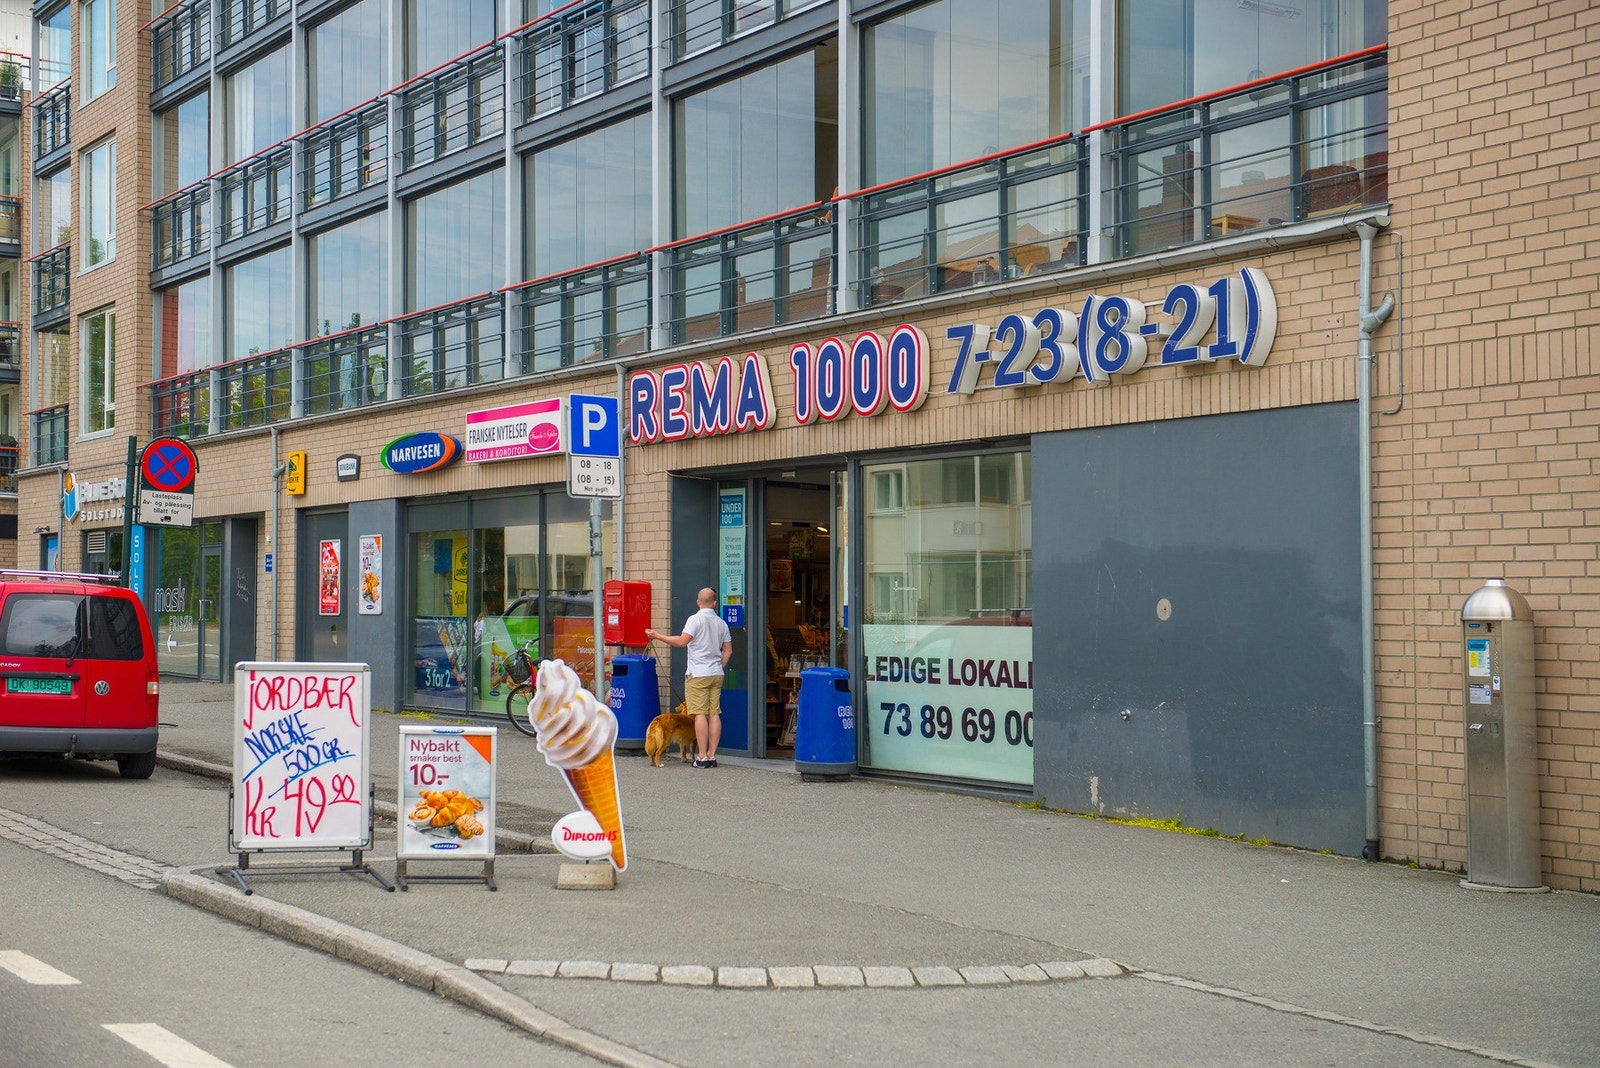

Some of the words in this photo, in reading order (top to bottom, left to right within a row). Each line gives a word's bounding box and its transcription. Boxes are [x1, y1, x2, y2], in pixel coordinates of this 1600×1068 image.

[946, 308, 1066, 394] 7-23
[1078, 266, 1264, 385] (8-21)
[629, 352, 772, 445] REMA
[790, 323, 926, 425] 1000
[468, 426, 496, 445] FRANSKE
[496, 422, 528, 442] NYTELSER
[582, 404, 608, 448] P
[391, 443, 441, 463] NARVESEN
[468, 451, 489, 461] BAKERI
[490, 450, 495, 458] &
[495, 446, 528, 459] KONDITORI
[580, 460, 592, 469] 08
[603, 461, 612, 470] 18
[577, 473, 592, 484] (08
[603, 475, 615, 486] 15)
[151, 492, 183, 501] Lasteplass
[153, 507, 168, 515] tillatt
[170, 508, 180, 516] for
[164, 500, 192, 510] pålessing
[721, 503, 742, 513] UNDER
[455, 568, 468, 576] DIRE
[425, 668, 431, 687] 3
[432, 669, 444, 687] for
[445, 670, 451, 687] 2
[864, 655, 941, 685] LEDIGE
[11, 679, 26, 689] DK
[32, 679, 69, 691] 90549
[880, 702, 912, 737] 73
[920, 704, 952, 740] 89
[961, 707, 996, 744] 69
[243, 710, 316, 764] NORSKE
[410, 739, 460, 754] Nybakt
[282, 744, 321, 779] 500
[409, 754, 441, 763] smaker
[443, 753, 462, 763] best
